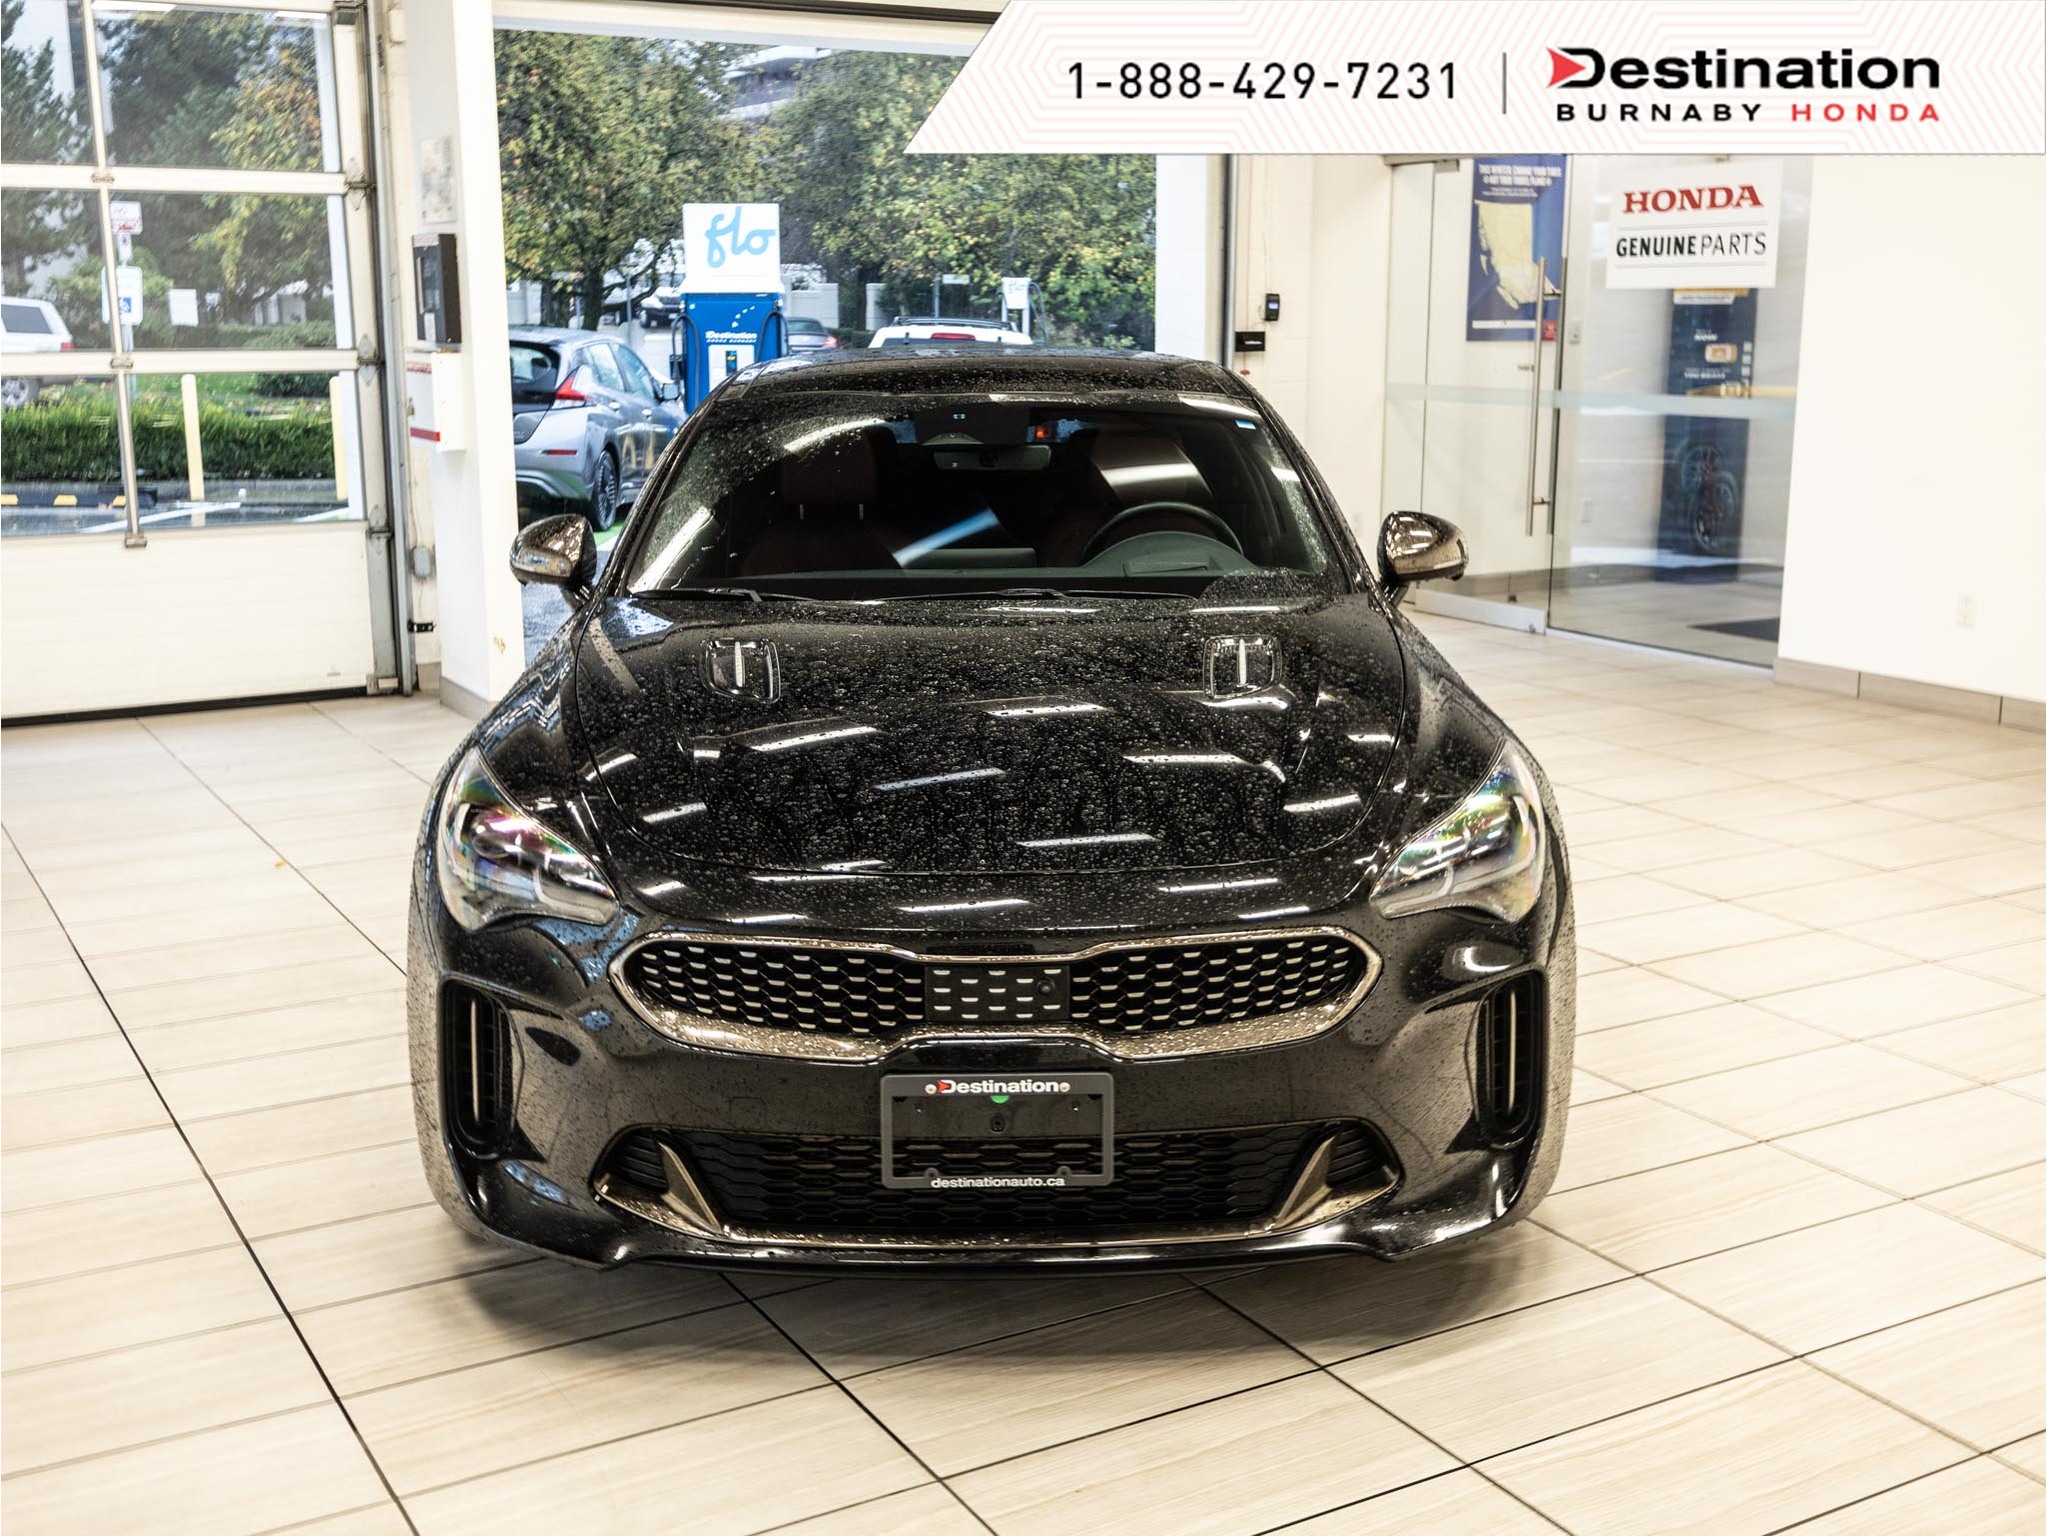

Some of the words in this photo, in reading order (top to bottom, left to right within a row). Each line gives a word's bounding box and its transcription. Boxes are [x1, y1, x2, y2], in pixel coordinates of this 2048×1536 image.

[1623, 185, 1763, 215] HONDA
[704, 206, 776, 268] flo
[1616, 235, 1697, 258] GENUINE
[1700, 232, 1767, 257] PARTS
[938, 1079, 1060, 1093] Destination
[931, 1177, 1066, 1189] destinationauto.ca
